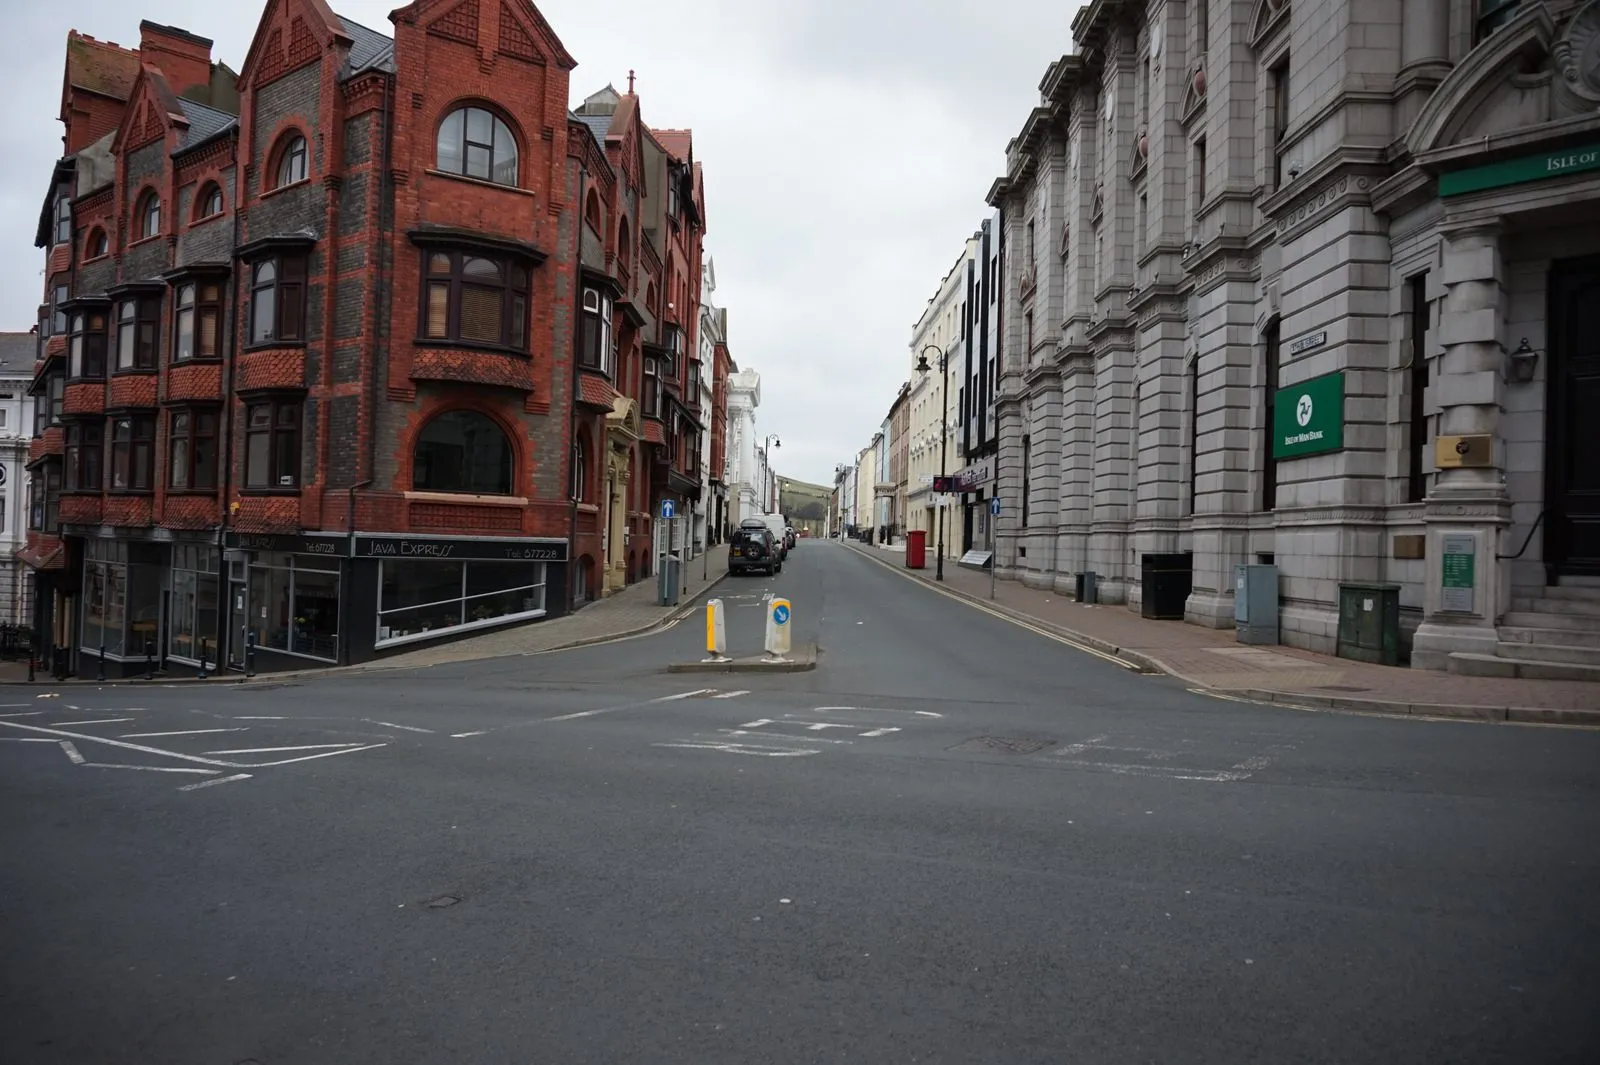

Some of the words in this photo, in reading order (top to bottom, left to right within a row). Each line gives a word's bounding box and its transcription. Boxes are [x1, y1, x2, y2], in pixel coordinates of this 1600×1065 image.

[1547, 156, 1577, 171] ISLE
[1299, 433, 1309, 443] MAN
[1310, 430, 1323, 440] BANK
[367, 540, 397, 556] JAVA
[400, 540, 454, 557] EXPRESS
